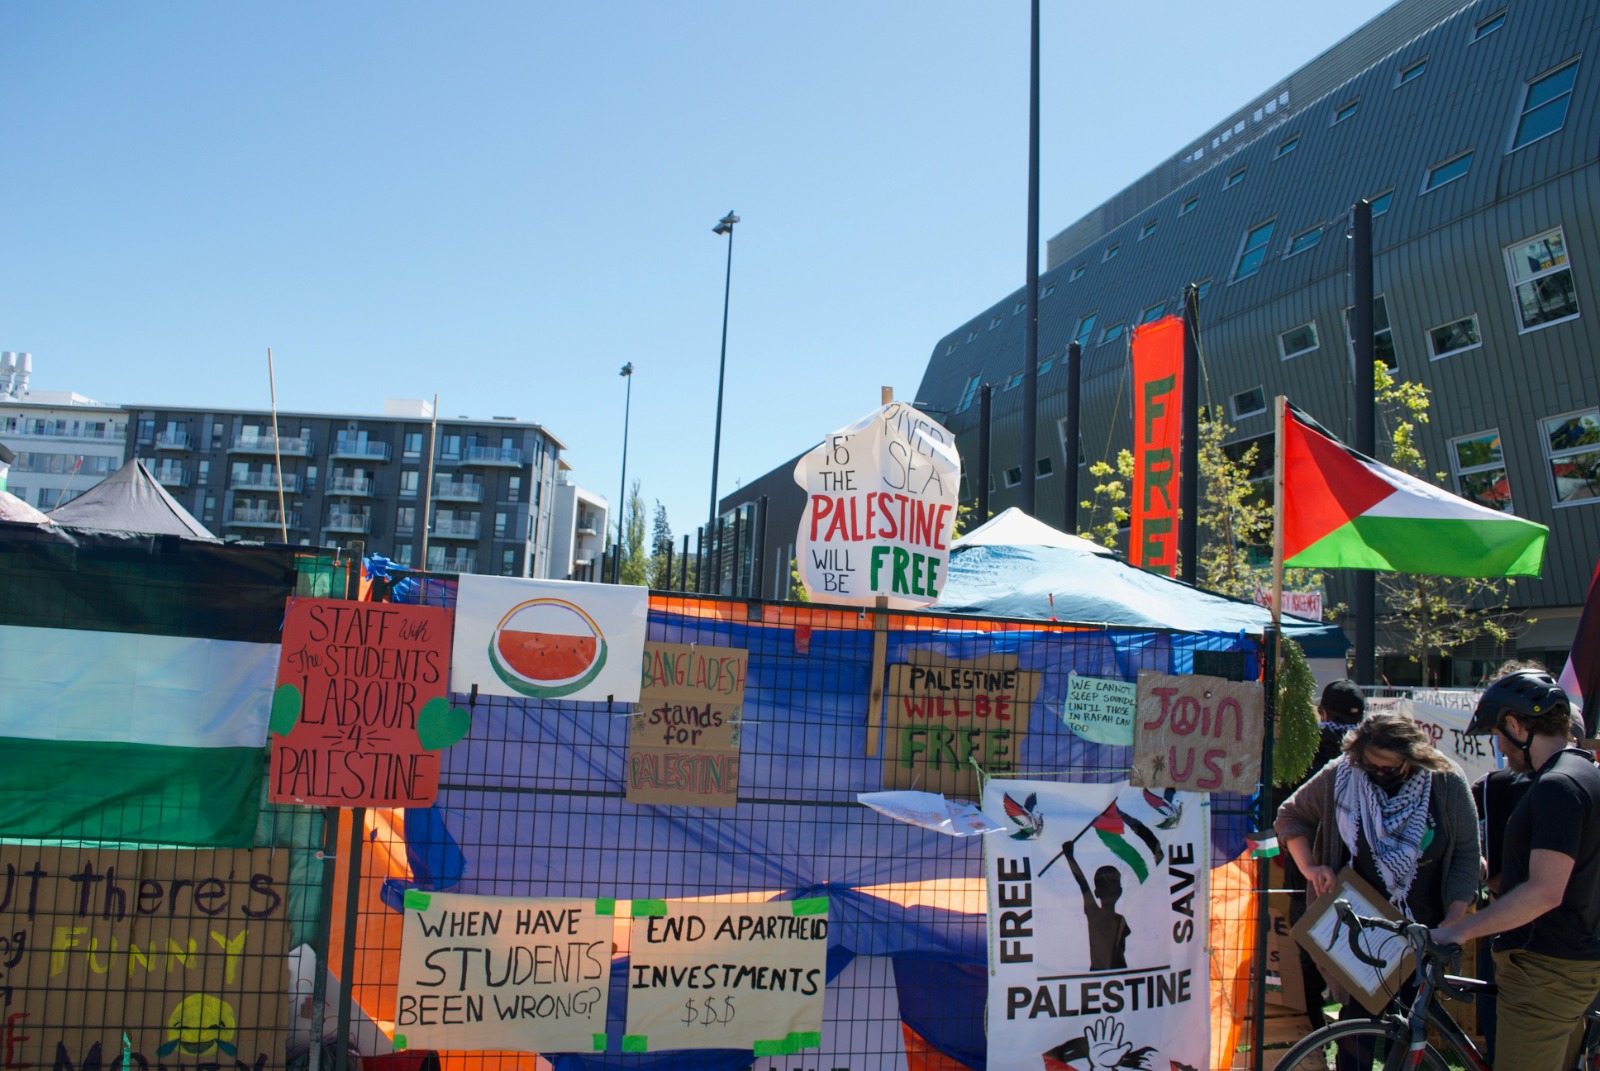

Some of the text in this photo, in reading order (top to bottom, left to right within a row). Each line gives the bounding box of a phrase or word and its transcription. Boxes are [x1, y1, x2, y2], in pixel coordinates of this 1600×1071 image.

[819, 470, 857, 491] THE
[883, 440, 943, 496] SEA
[810, 492, 952, 550] PALESTINE
[812, 549, 855, 572] WILL
[870, 545, 941, 598] FREE
[822, 573, 850, 594] BE
[308, 604, 400, 646] STAFF
[324, 644, 440, 684] STUDENTS
[642, 650, 747, 695] BANGLADESH
[909, 668, 1016, 691] PALESTINE
[301, 676, 418, 729] LABOUR
[1070, 691, 1098, 701] SLEEP
[1072, 679, 1132, 694] WE CANNOT
[648, 702, 723, 728] stands
[1068, 703, 1129, 716] UNTIL THOSE
[1068, 712, 1130, 726] IN RAFAH CAN
[1070, 722, 1089, 732] TOO
[345, 725, 363, 751] 4
[664, 724, 702, 745] for
[901, 723, 1011, 772] FREE
[277, 747, 432, 801] PALESTINE
[630, 751, 738, 795] PALESTINE
[69, 859, 282, 922] there's
[997, 856, 1034, 964] FREE
[1168, 842, 1195, 944] SAVE
[417, 909, 583, 938] WHEN HAVE
[647, 915, 828, 944] END APARTHEID
[50, 925, 249, 985] FUNNY
[416, 941, 604, 991] STUDENTS
[632, 964, 821, 996] INVESTMENTS
[1006, 968, 1192, 1020] PALESTINE
[398, 986, 601, 1026] BEEN WRONG?
[681, 996, 736, 1028] $$$
